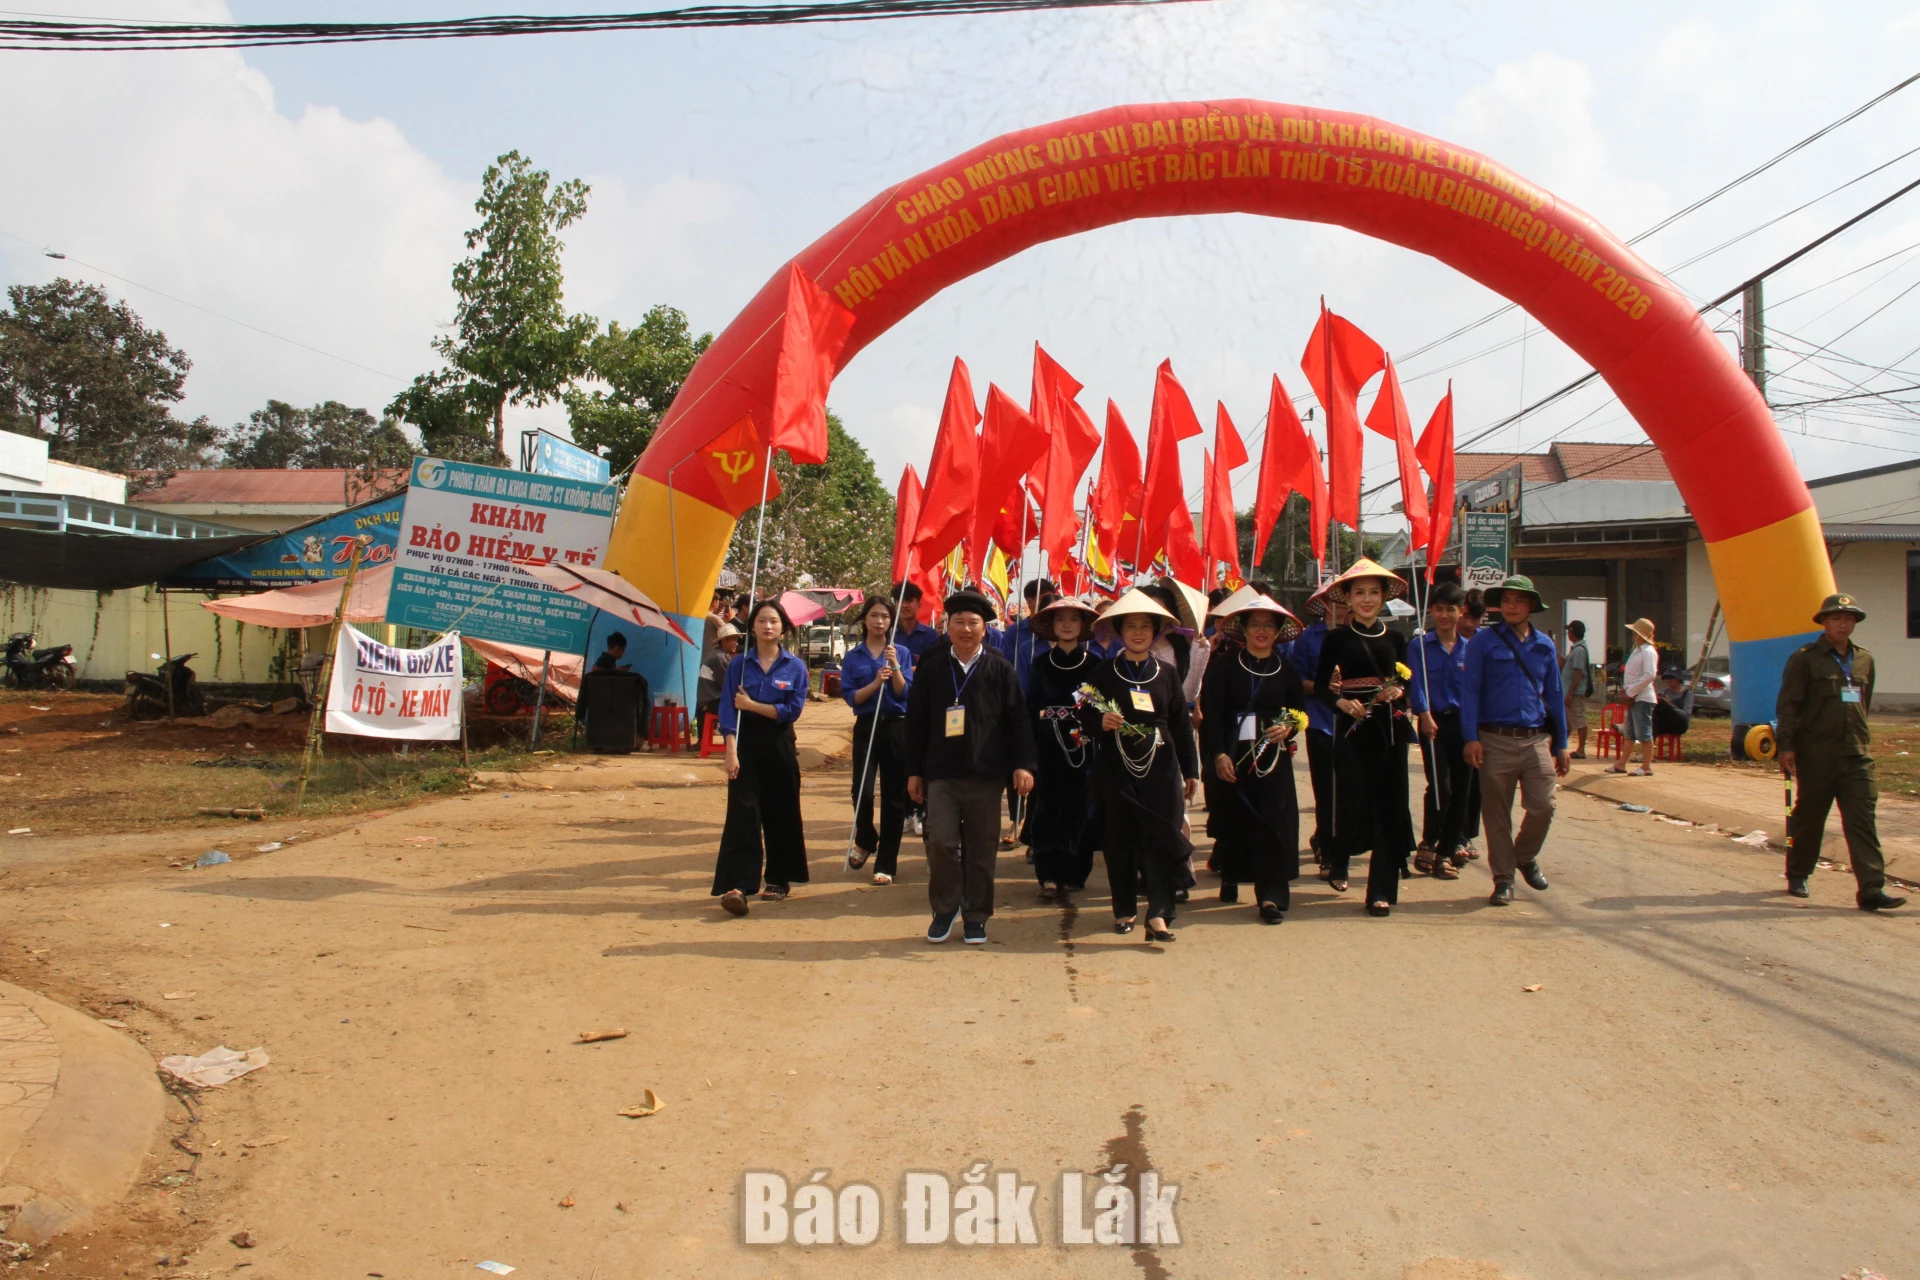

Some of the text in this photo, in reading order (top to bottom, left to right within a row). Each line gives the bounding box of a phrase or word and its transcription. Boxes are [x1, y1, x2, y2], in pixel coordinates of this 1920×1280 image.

[895, 176, 965, 225] CHÀO
[963, 144, 1045, 191] MỪNG
[1100, 125, 1130, 156] VỊ
[1131, 118, 1178, 151] ĐẠI
[1181, 108, 1240, 143] BIỂU
[1244, 112, 1276, 140] VÀ
[1282, 117, 1314, 144] DU
[1321, 117, 1406, 157] KHÁCH
[833, 141, 1653, 321] HỘI VĂN HÓA DÂN GIAN VIỆT BẮC LẦN THỨ 15 XUÂN BÍNH NGỌ NĂM 2026
[448, 468, 474, 489] PHÒNG
[473, 472, 496, 492] KHÁM
[496, 478, 508, 494] ĐA
[508, 480, 528, 497] KHOA
[528, 483, 553, 501] MEDIC
[553, 487, 563, 502] CT
[563, 486, 590, 506] KRÔNG
[355, 511, 399, 529] DỊCH VỤ
[470, 503, 546, 533] KHÁM
[409, 523, 461, 552] BẢO
[466, 531, 534, 561] HIỂM
[541, 546, 557, 563] Y
[406, 549, 429, 558] PHỤC
[432, 553, 443, 561] VỤ
[446, 556, 473, 566] 07H00
[482, 562, 509, 571] 17H00
[430, 564, 444, 573] TẤT
[462, 570, 479, 579] CÁC
[509, 579, 538, 588] TRONG
[435, 602, 461, 611] VACCIN
[434, 645, 455, 673] XE
[351, 678, 364, 713] Ô
[367, 681, 387, 717] TÔ
[398, 690, 418, 718] XE
[420, 684, 451, 718] MÁY
